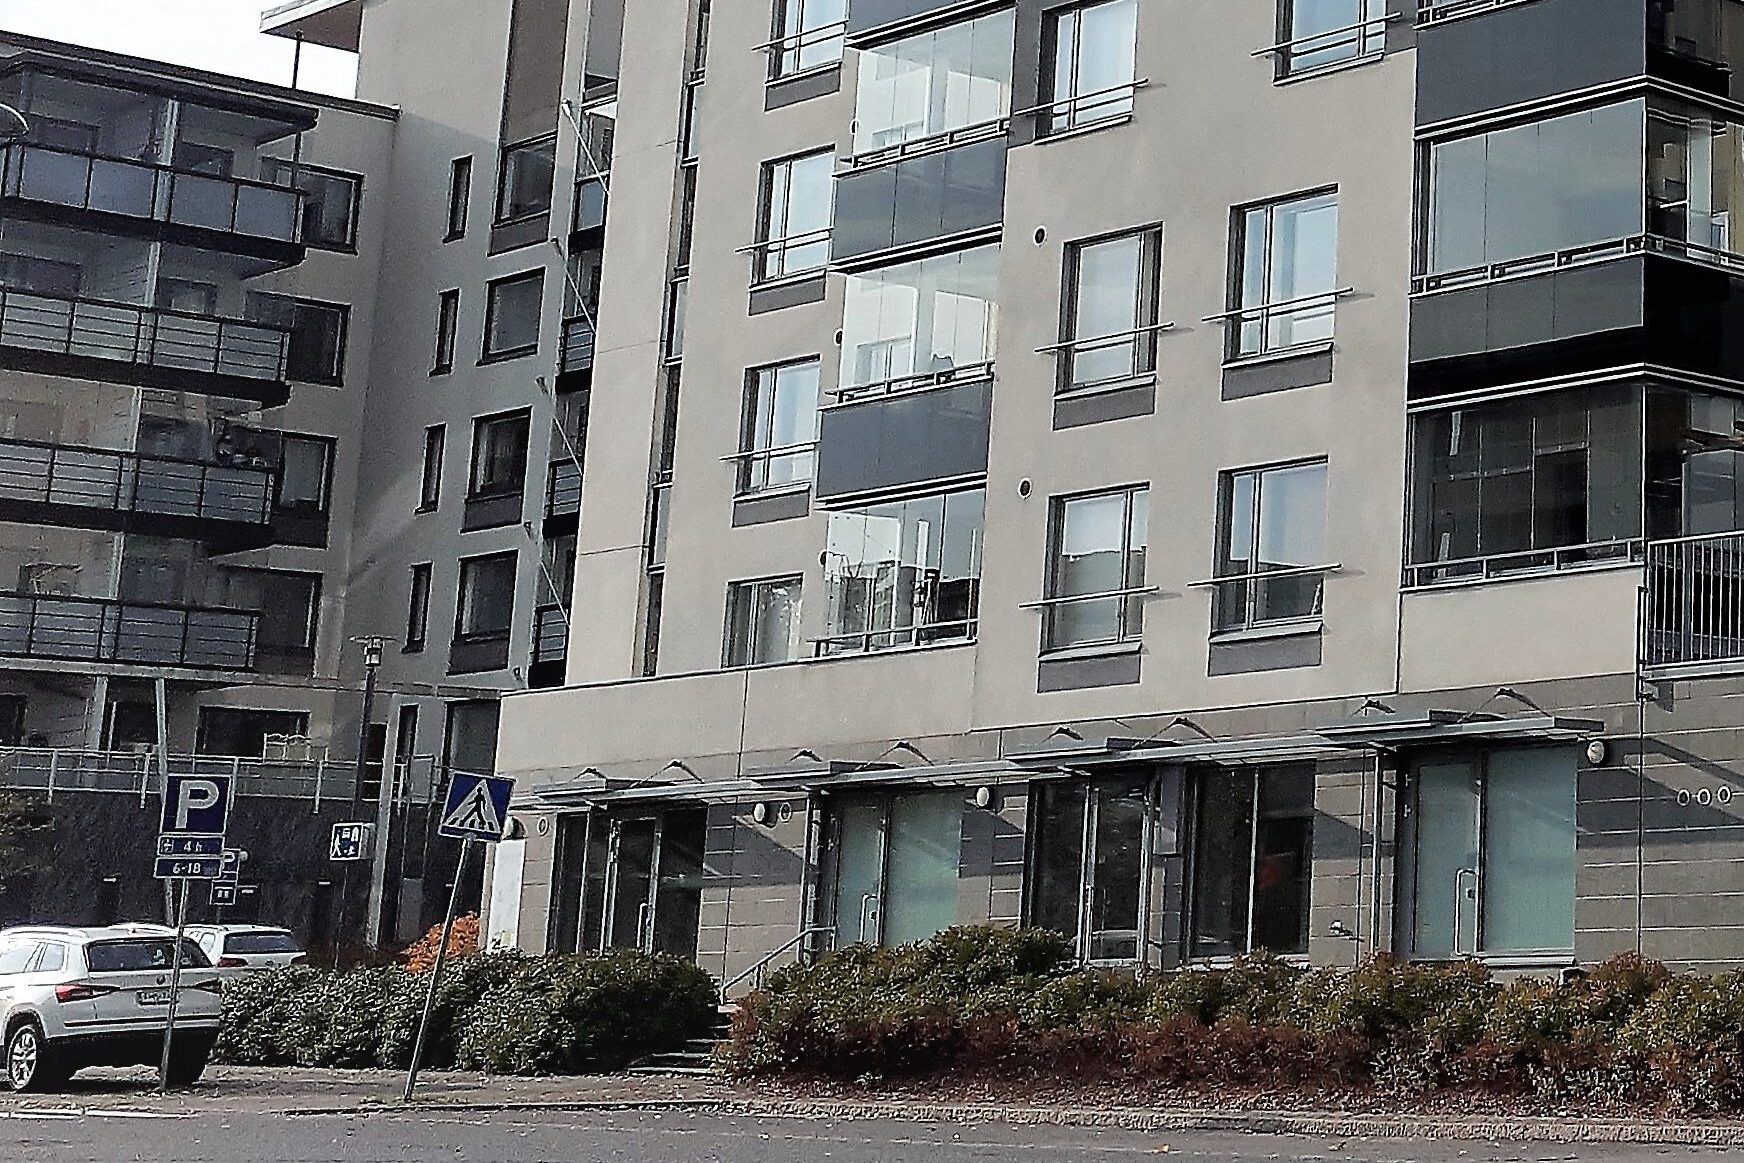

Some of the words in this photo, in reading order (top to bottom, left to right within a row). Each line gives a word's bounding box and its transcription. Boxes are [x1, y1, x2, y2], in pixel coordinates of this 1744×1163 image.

[174, 780, 219, 829] P
[183, 840, 192, 852] 4
[172, 862, 201, 874] 6-18
